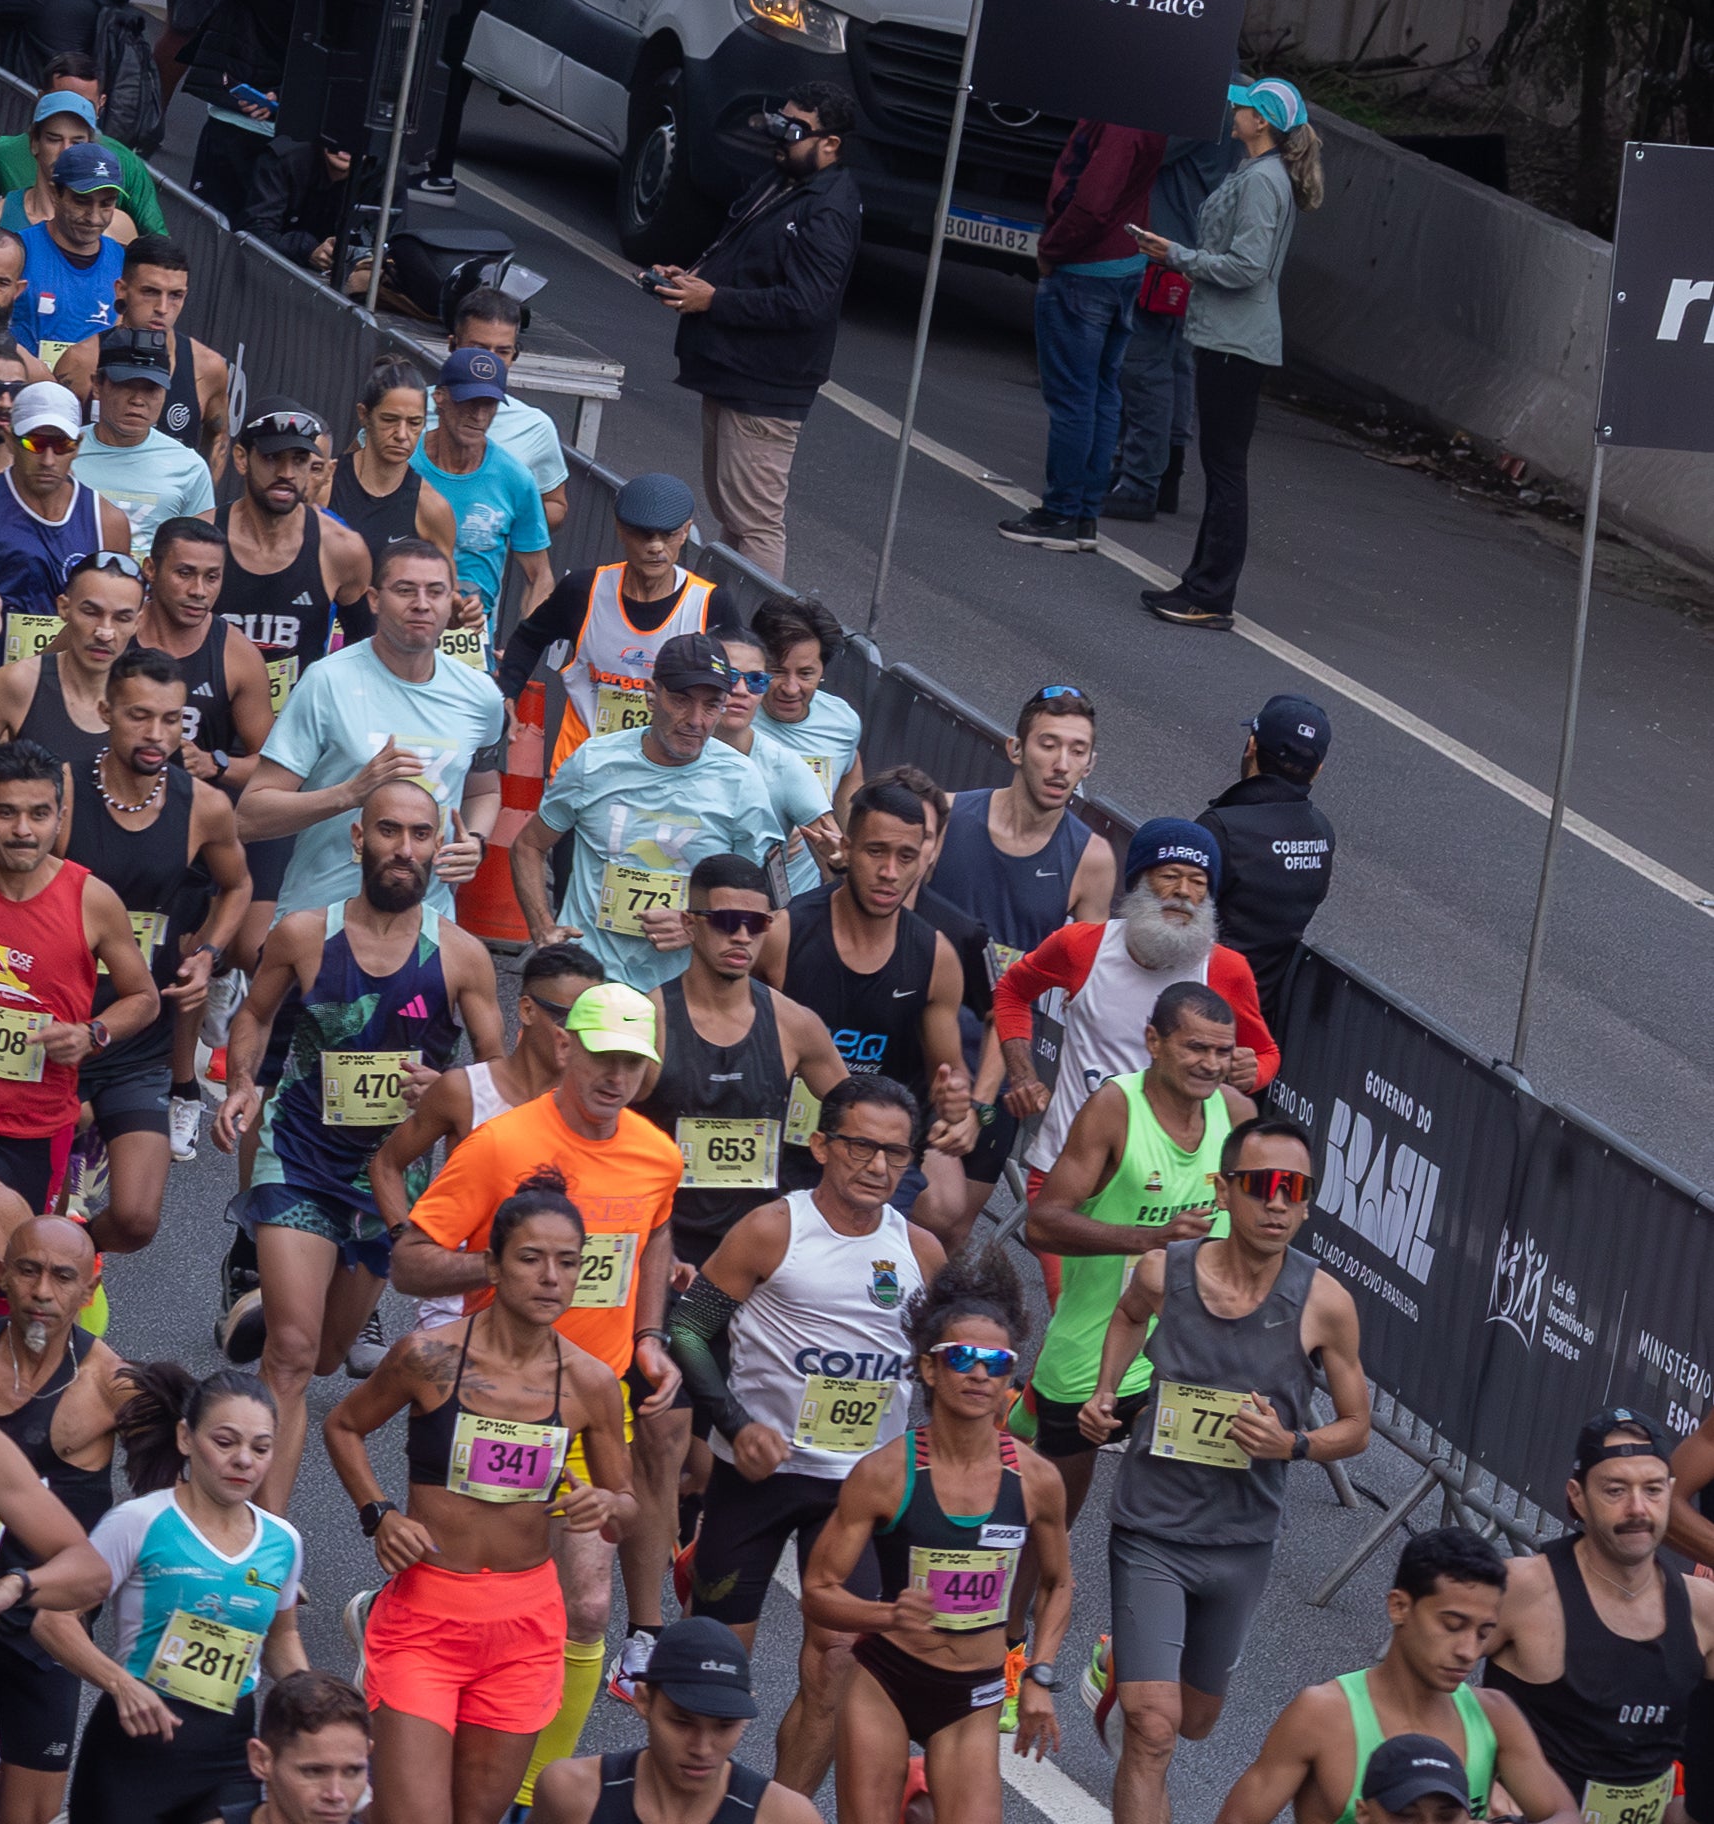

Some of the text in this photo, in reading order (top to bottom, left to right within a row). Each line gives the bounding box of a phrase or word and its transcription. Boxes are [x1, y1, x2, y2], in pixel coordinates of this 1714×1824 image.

[1157, 845, 1210, 867] BARROS
[1271, 840, 1330, 855] COBERTURA
[1284, 856, 1323, 870] OFICIAL
[354, 1073, 401, 1099] 470
[1299, 1097, 1314, 1127] DO
[1365, 1069, 1432, 1134] GOVERNO DO
[707, 1138, 756, 1163] 653
[1315, 1096, 1441, 1285] BRASIL
[1312, 1231, 1419, 1322] DO LADO DO POVO BRASILEIRO
[1552, 1272, 1576, 1306] Lei de
[1541, 1323, 1574, 1360] Esporte
[1582, 1325, 1594, 1346] ao
[795, 1348, 903, 1382] COTIA
[1638, 1329, 1712, 1400] MINISTÉRIO
[830, 1399, 876, 1426] 692
[487, 1443, 539, 1476] 341
[985, 1528, 1023, 1539] BROOKS
[944, 1573, 996, 1603] 440
[181, 1645, 247, 1686] 2811
